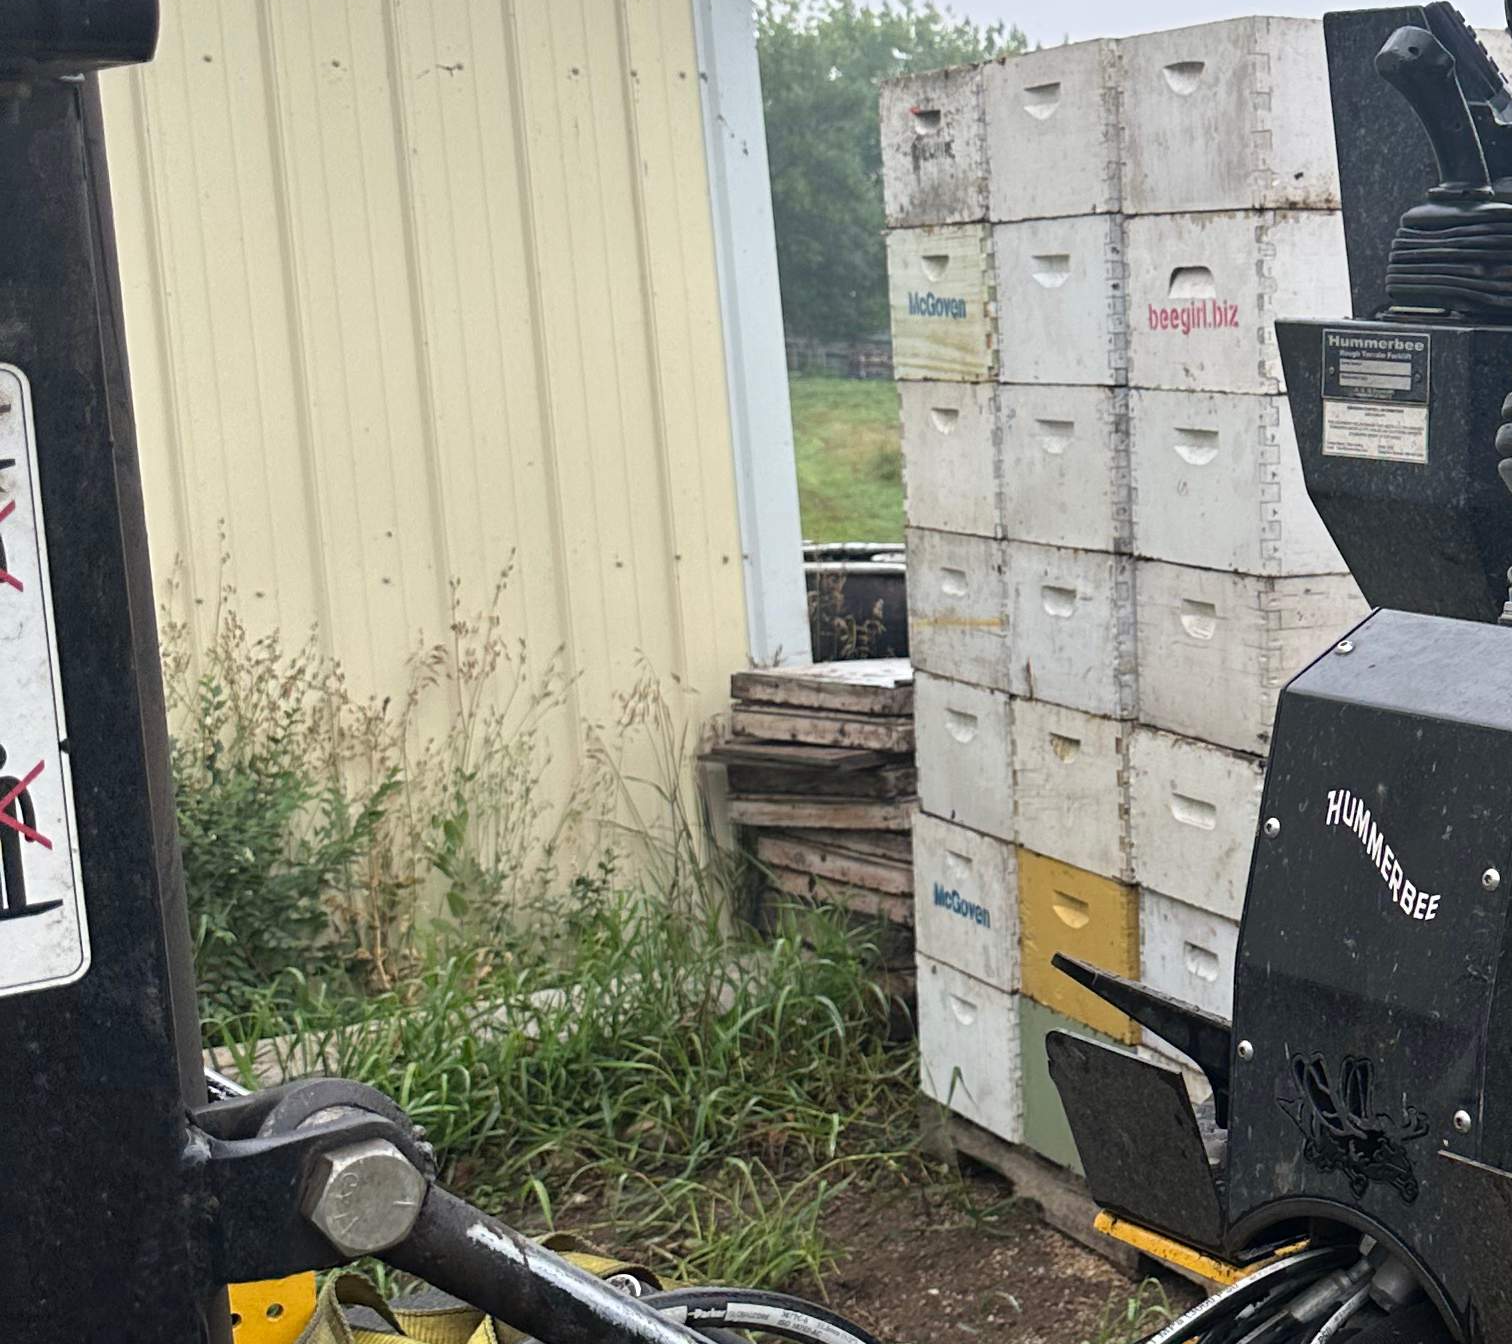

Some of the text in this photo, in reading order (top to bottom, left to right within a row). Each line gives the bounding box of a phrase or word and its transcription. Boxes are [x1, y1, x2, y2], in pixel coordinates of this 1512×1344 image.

[908, 291, 967, 319] McGoven
[1148, 299, 1239, 335] beegirl.biz
[1327, 335, 1425, 352] Hummerbee
[1326, 789, 1441, 921] HUMMERBEE
[933, 881, 991, 928] McGoven
